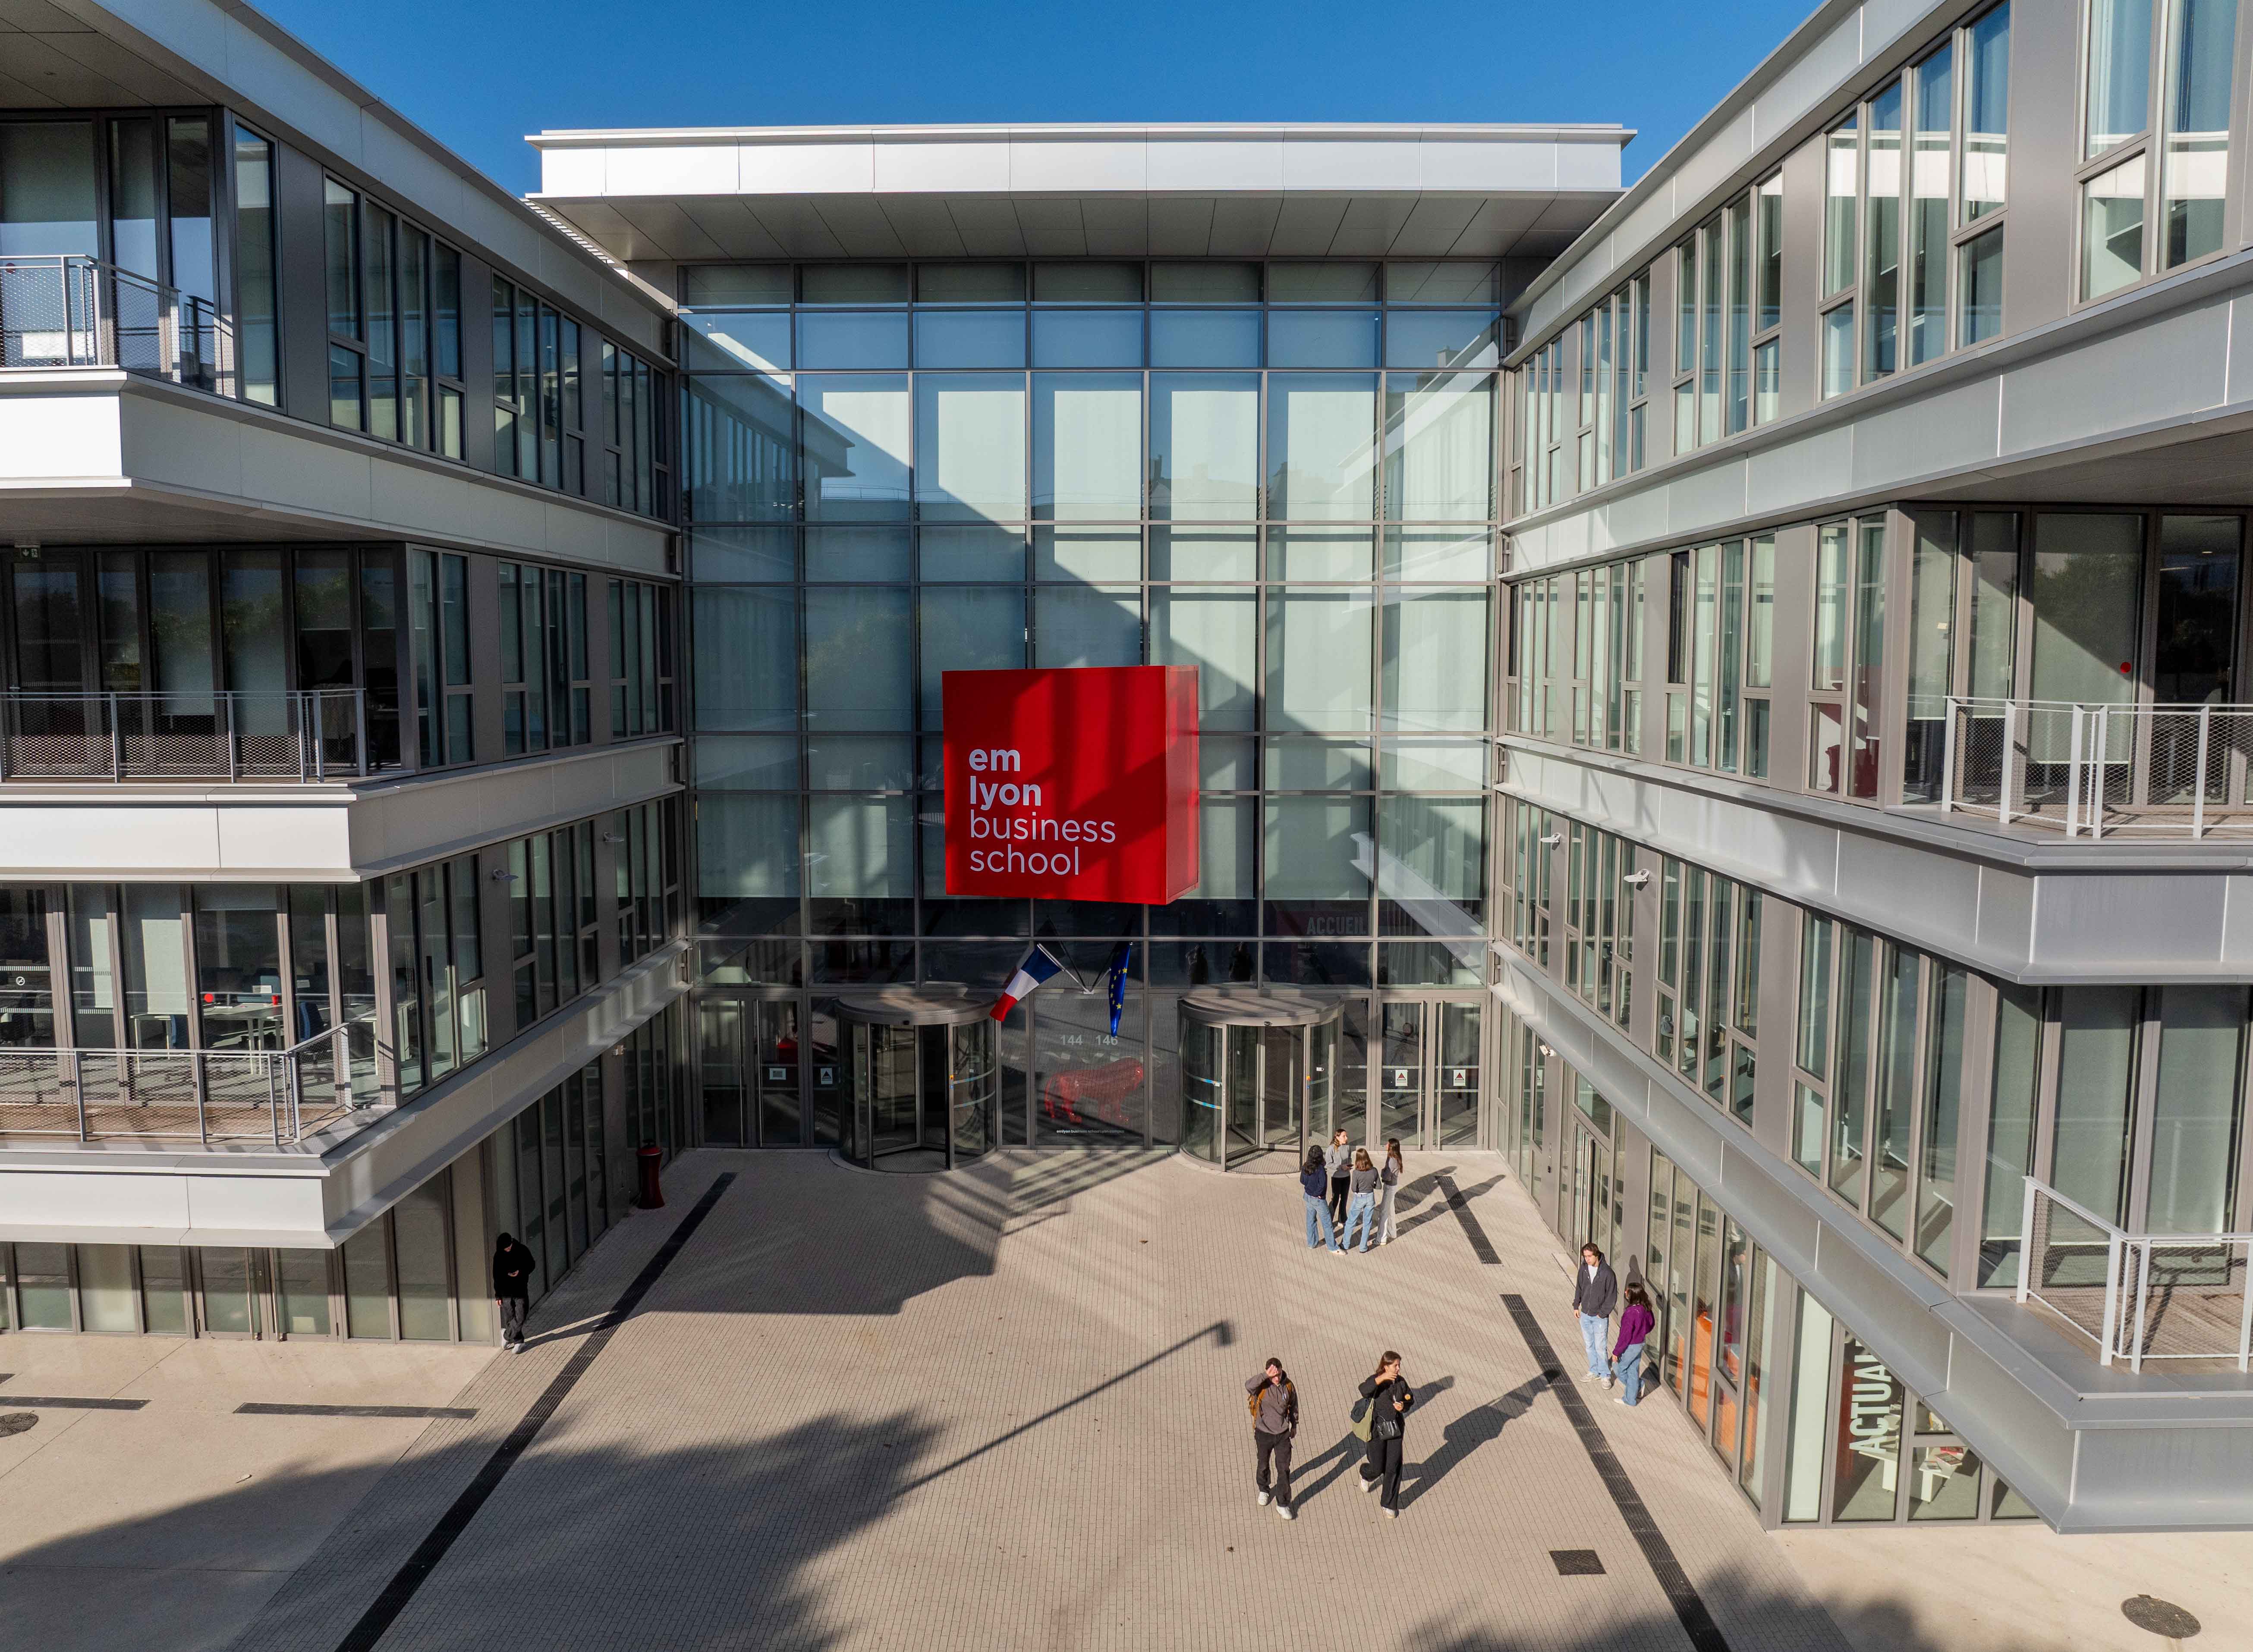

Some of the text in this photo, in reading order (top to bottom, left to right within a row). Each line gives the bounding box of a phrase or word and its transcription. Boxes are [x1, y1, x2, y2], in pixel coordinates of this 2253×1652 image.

[969, 749, 1020, 771] em
[970, 776, 1041, 810] lyon
[971, 809, 1116, 843] business
[970, 844, 1079, 875] school
[1306, 917, 1367, 935] ACCUEIL
[1060, 1035, 1118, 1046] 144 146
